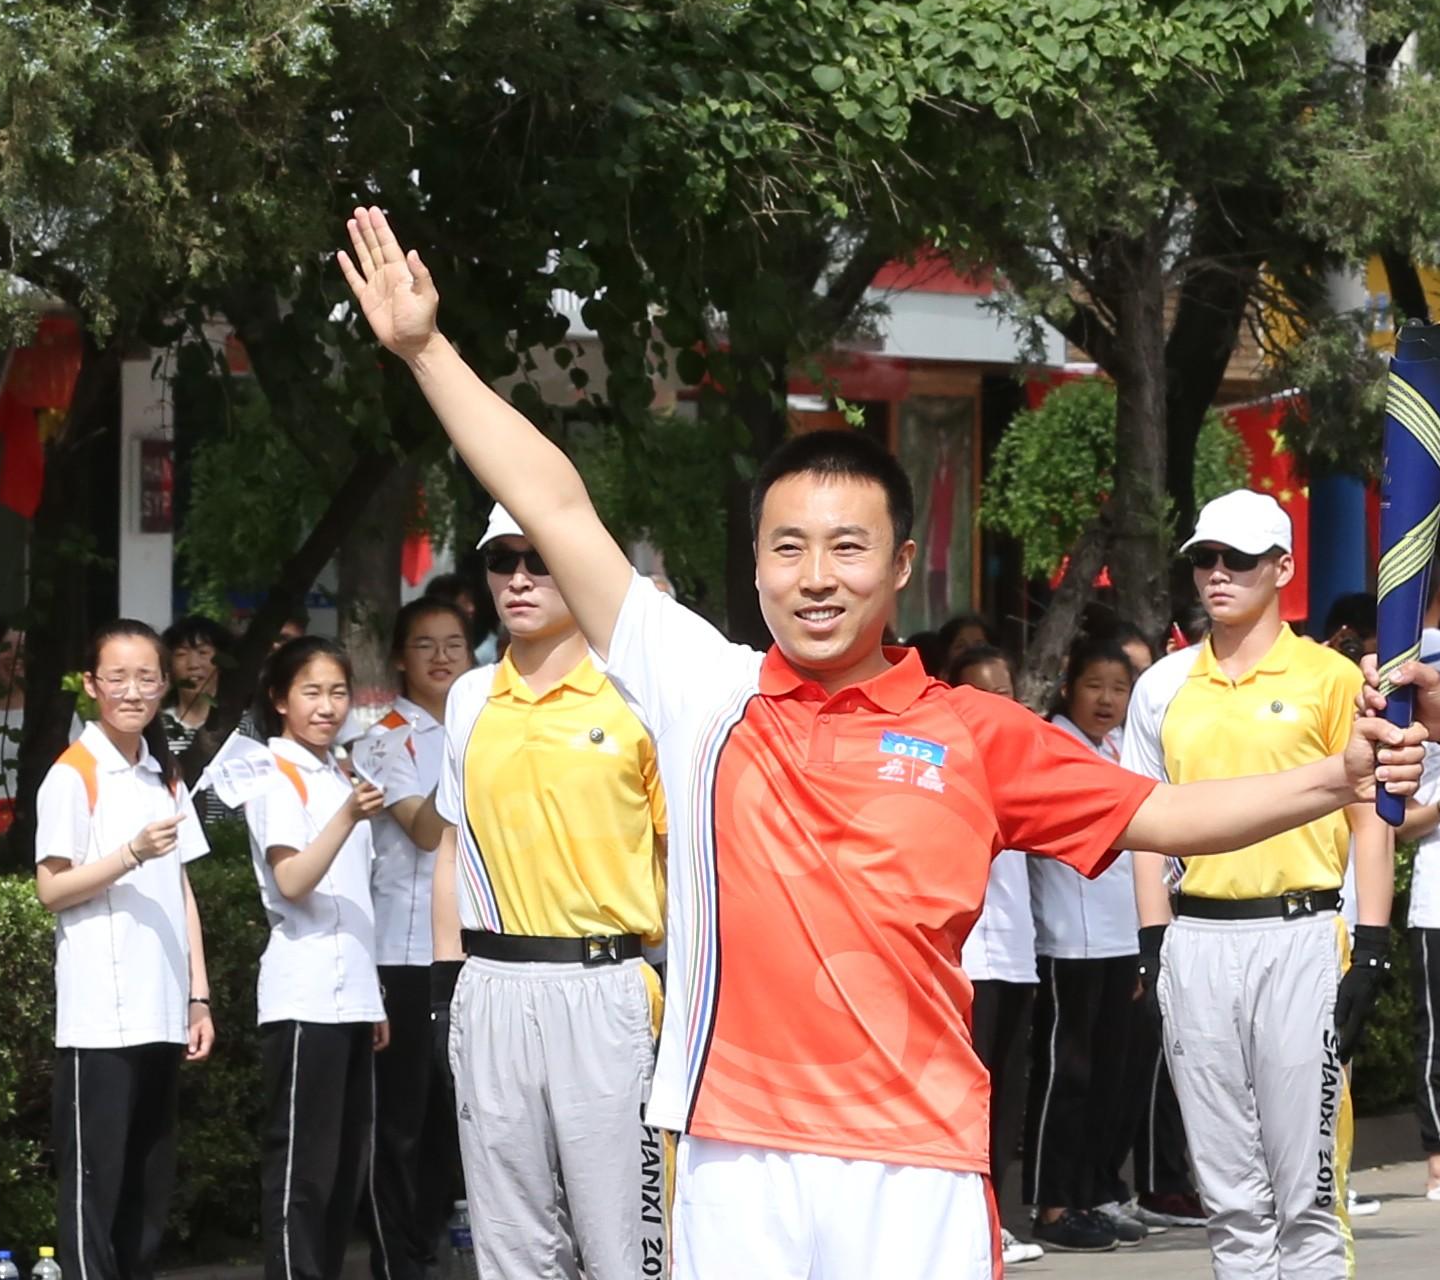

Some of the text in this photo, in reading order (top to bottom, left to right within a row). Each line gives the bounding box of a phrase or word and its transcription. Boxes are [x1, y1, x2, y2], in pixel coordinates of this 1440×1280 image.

[894, 742, 934, 761] 012
[639, 1102, 662, 1225] HANXI
[1315, 1148, 1334, 1208] 2019
